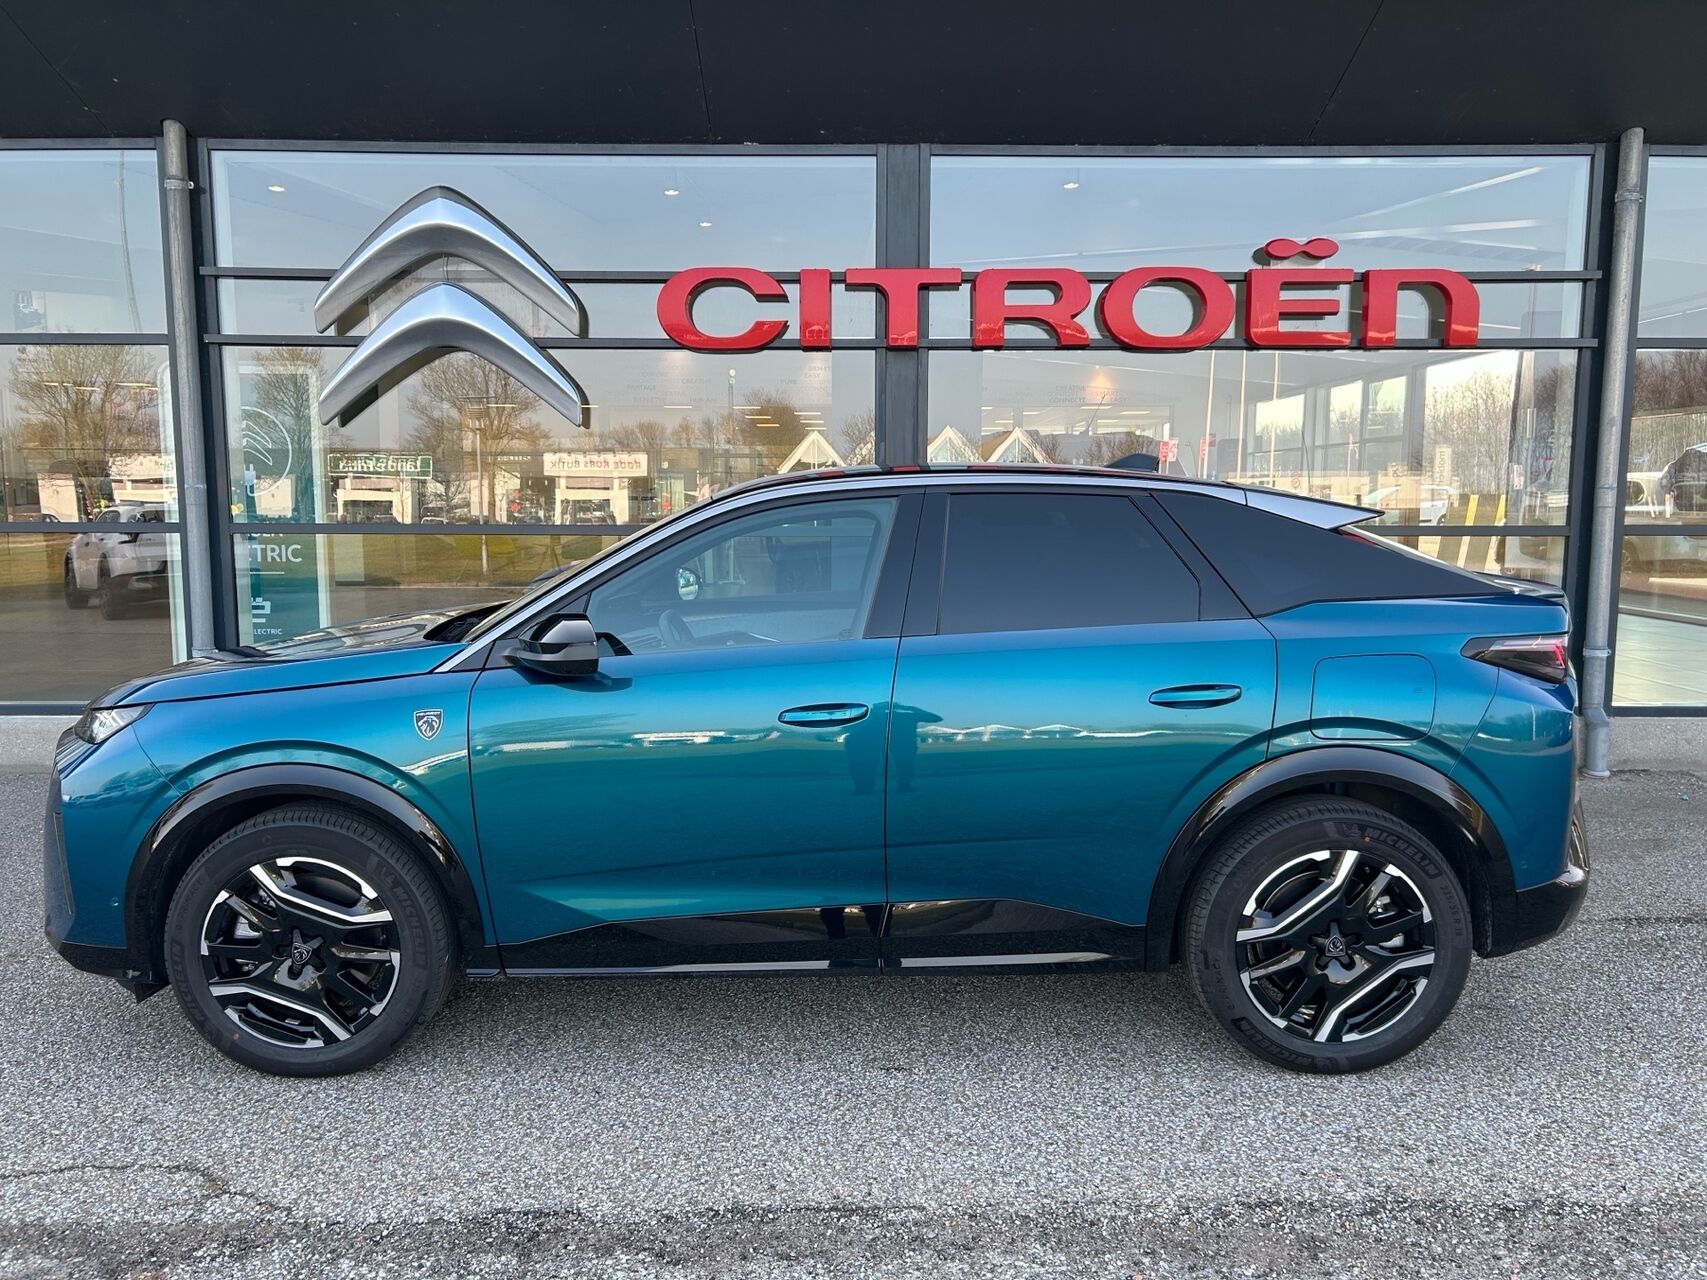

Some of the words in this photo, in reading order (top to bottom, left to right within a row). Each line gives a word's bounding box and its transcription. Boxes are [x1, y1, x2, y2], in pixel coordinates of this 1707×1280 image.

[656, 237, 1481, 353] CITROËN
[248, 544, 303, 562] TRIC
[1364, 826, 1440, 876] MICHELIN
[392, 886, 426, 966] MICHELIN
[171, 942, 205, 1021] MICHELIN
